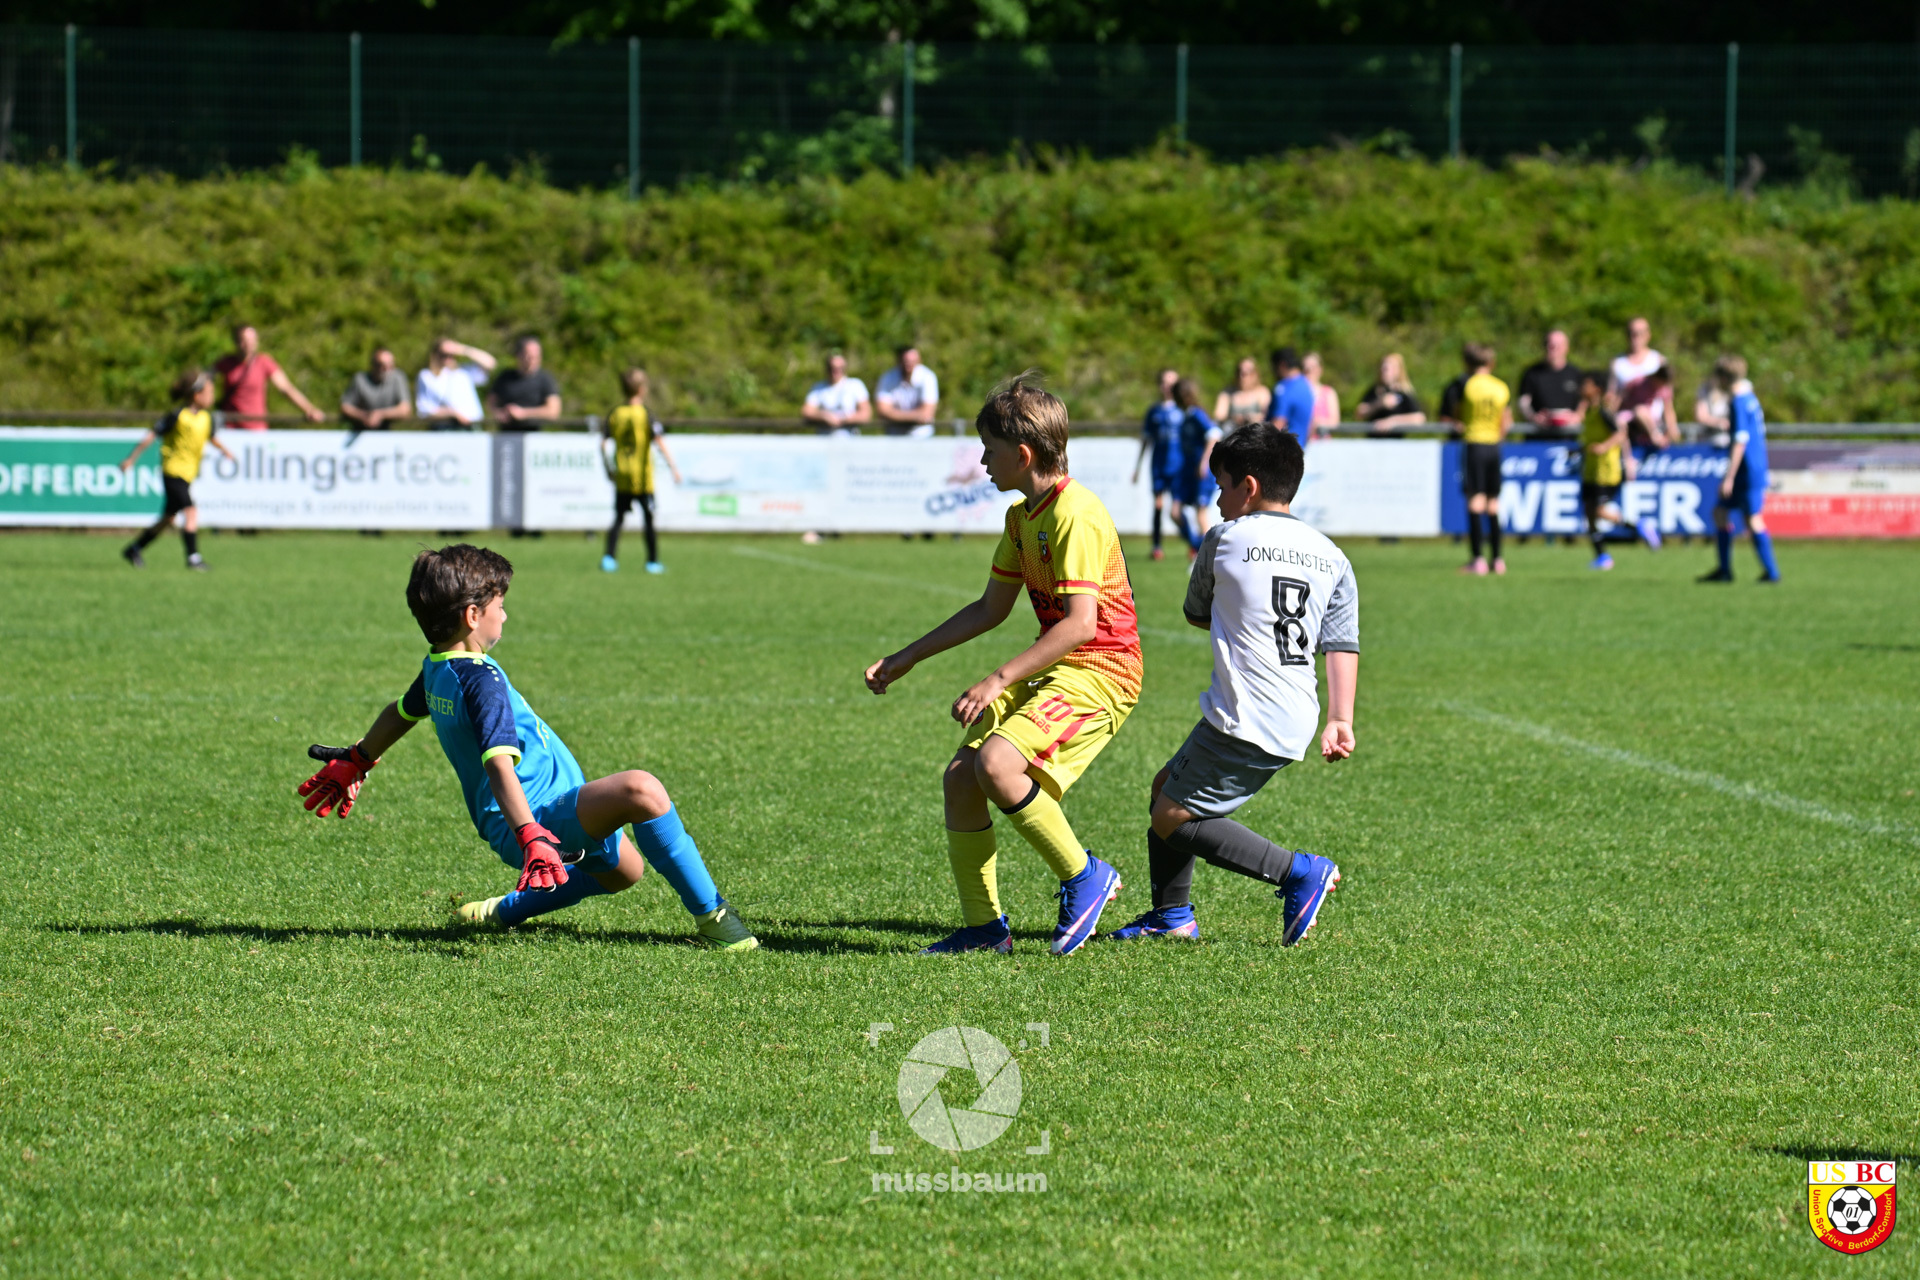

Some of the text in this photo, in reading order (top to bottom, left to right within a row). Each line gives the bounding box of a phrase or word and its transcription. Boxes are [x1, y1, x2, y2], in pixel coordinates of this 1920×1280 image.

[1494, 479, 1707, 534] WEER
[1271, 575, 1311, 666] 8
[1037, 693, 1074, 722] 10
